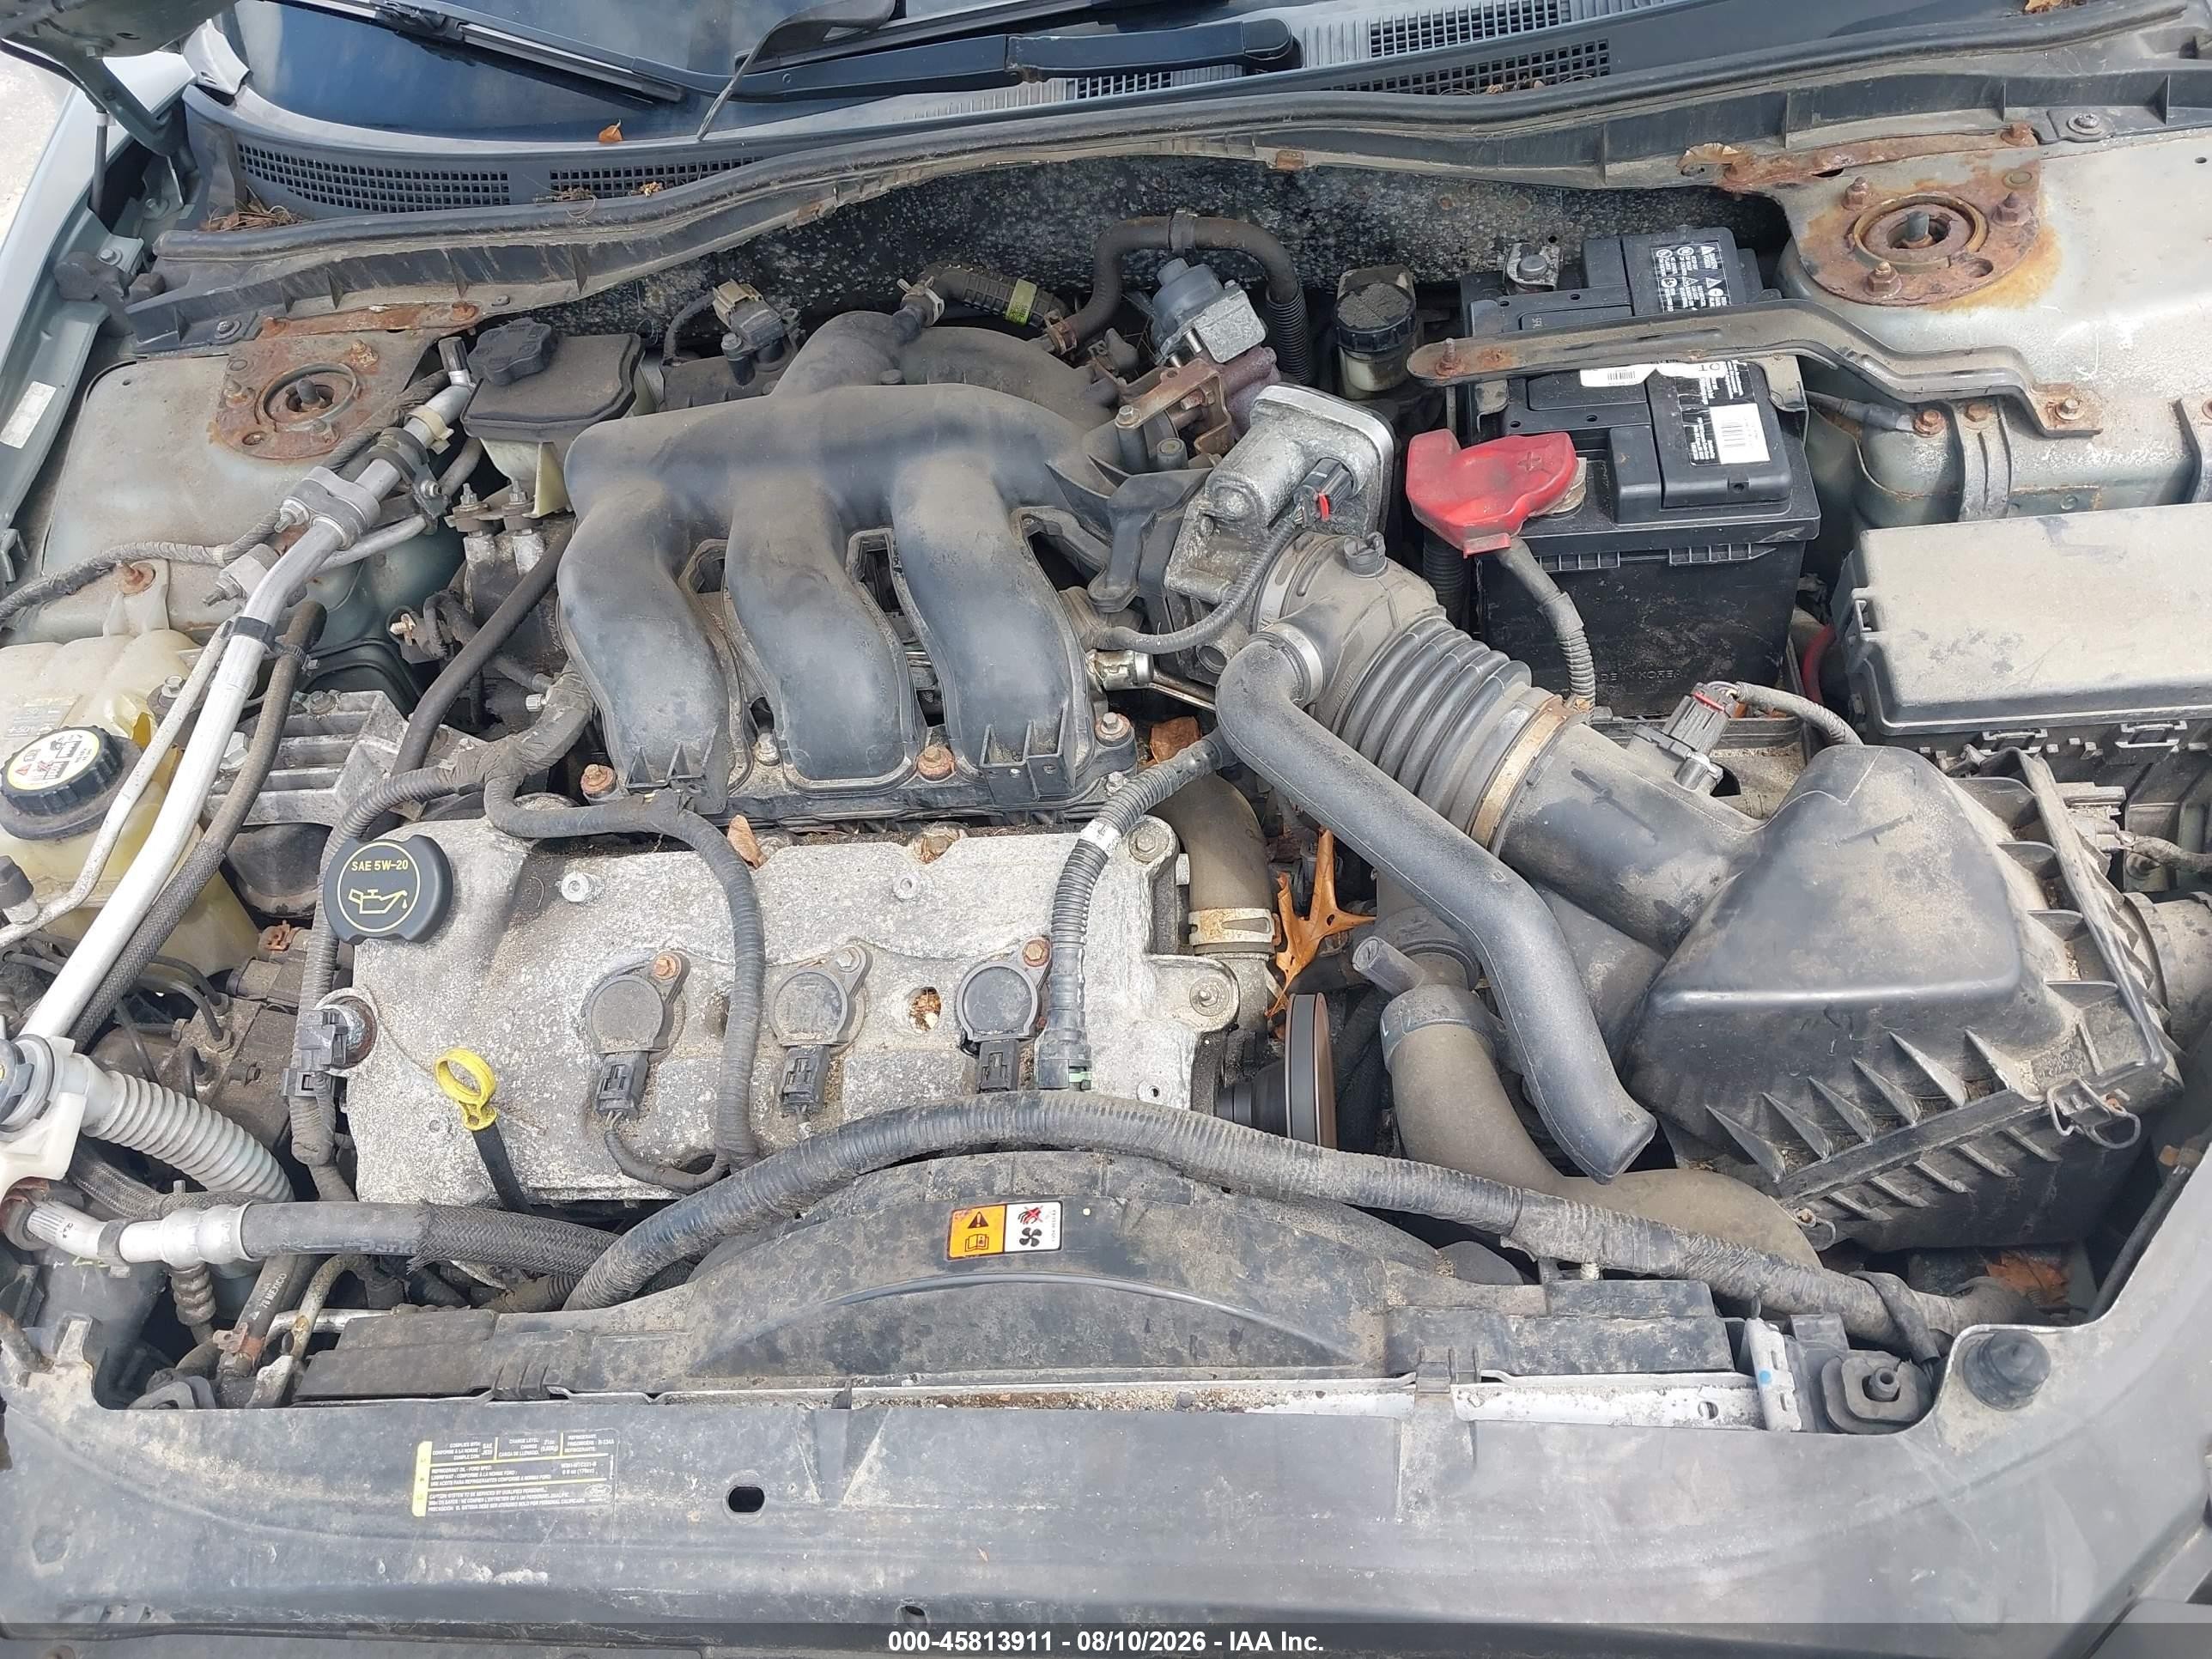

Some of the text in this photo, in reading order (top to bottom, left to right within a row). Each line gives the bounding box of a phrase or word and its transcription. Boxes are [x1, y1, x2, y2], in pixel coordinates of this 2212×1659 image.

[351, 859, 409, 871] SAE 5W-20
[264, 1273, 288, 1300] MEXICO
